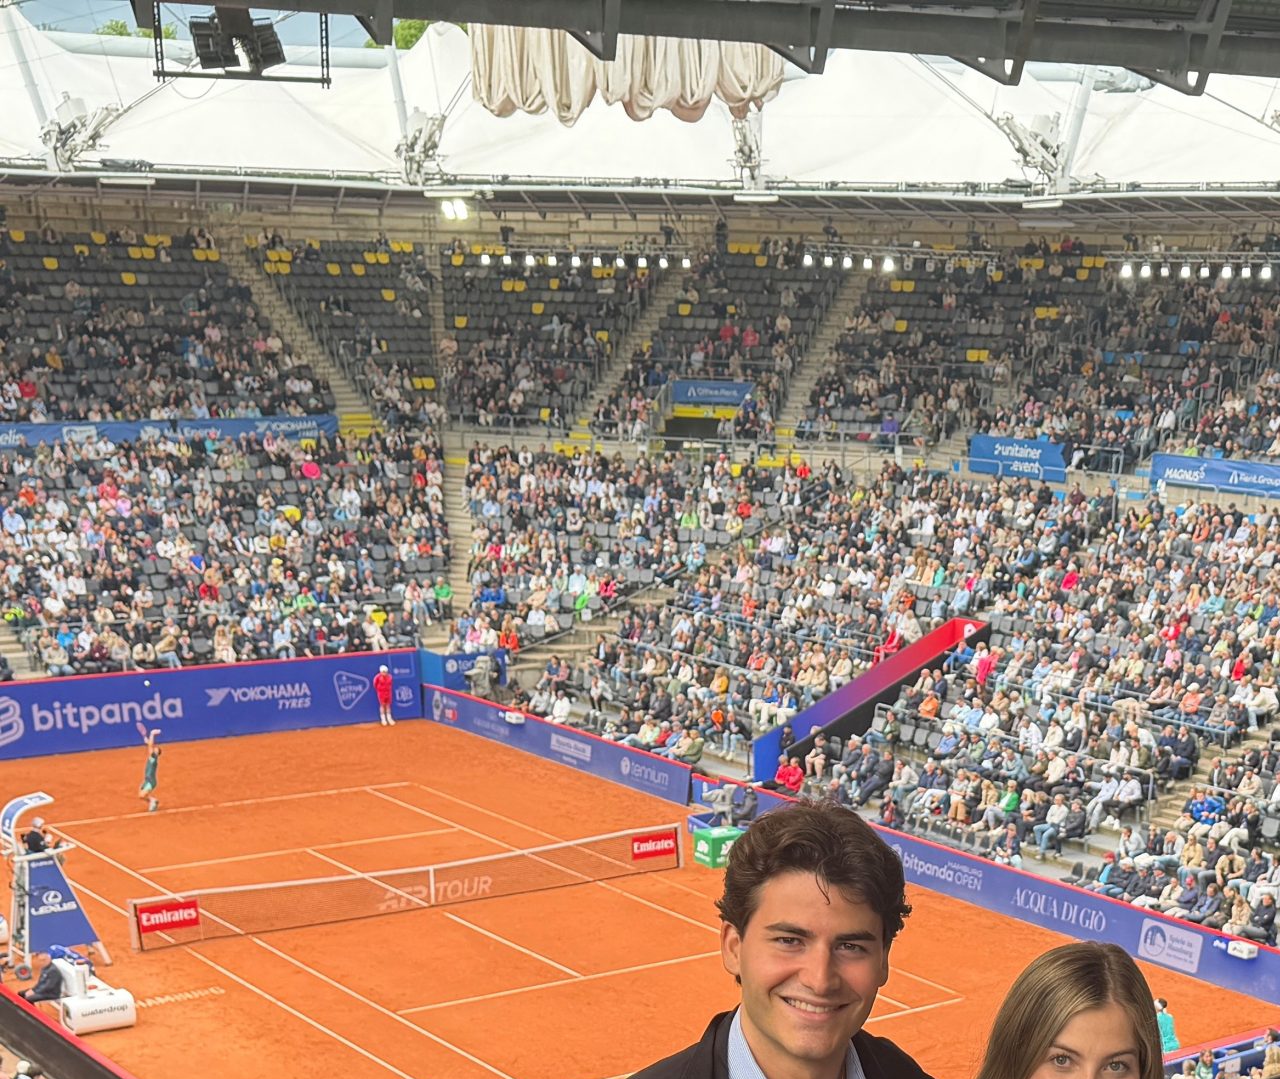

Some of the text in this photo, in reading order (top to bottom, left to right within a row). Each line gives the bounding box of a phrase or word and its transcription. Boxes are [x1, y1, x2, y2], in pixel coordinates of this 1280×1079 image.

[1001, 443, 1041, 459] unitainer
[1164, 468, 1200, 482] MAGNUS
[231, 682, 311, 703] YOKOHAMA
[31, 692, 183, 734] bitpanda
[277, 697, 311, 710] TYRES
[631, 760, 669, 787] tennium
[633, 837, 675, 854] Emirates
[903, 851, 983, 891] bitpanda OPEN
[435, 875, 493, 902] TOUR
[30, 901, 78, 916] LEXUS
[1011, 886, 1059, 919] ACQUA
[1060, 904, 1076, 924] DI
[141, 907, 198, 926] Emirates
